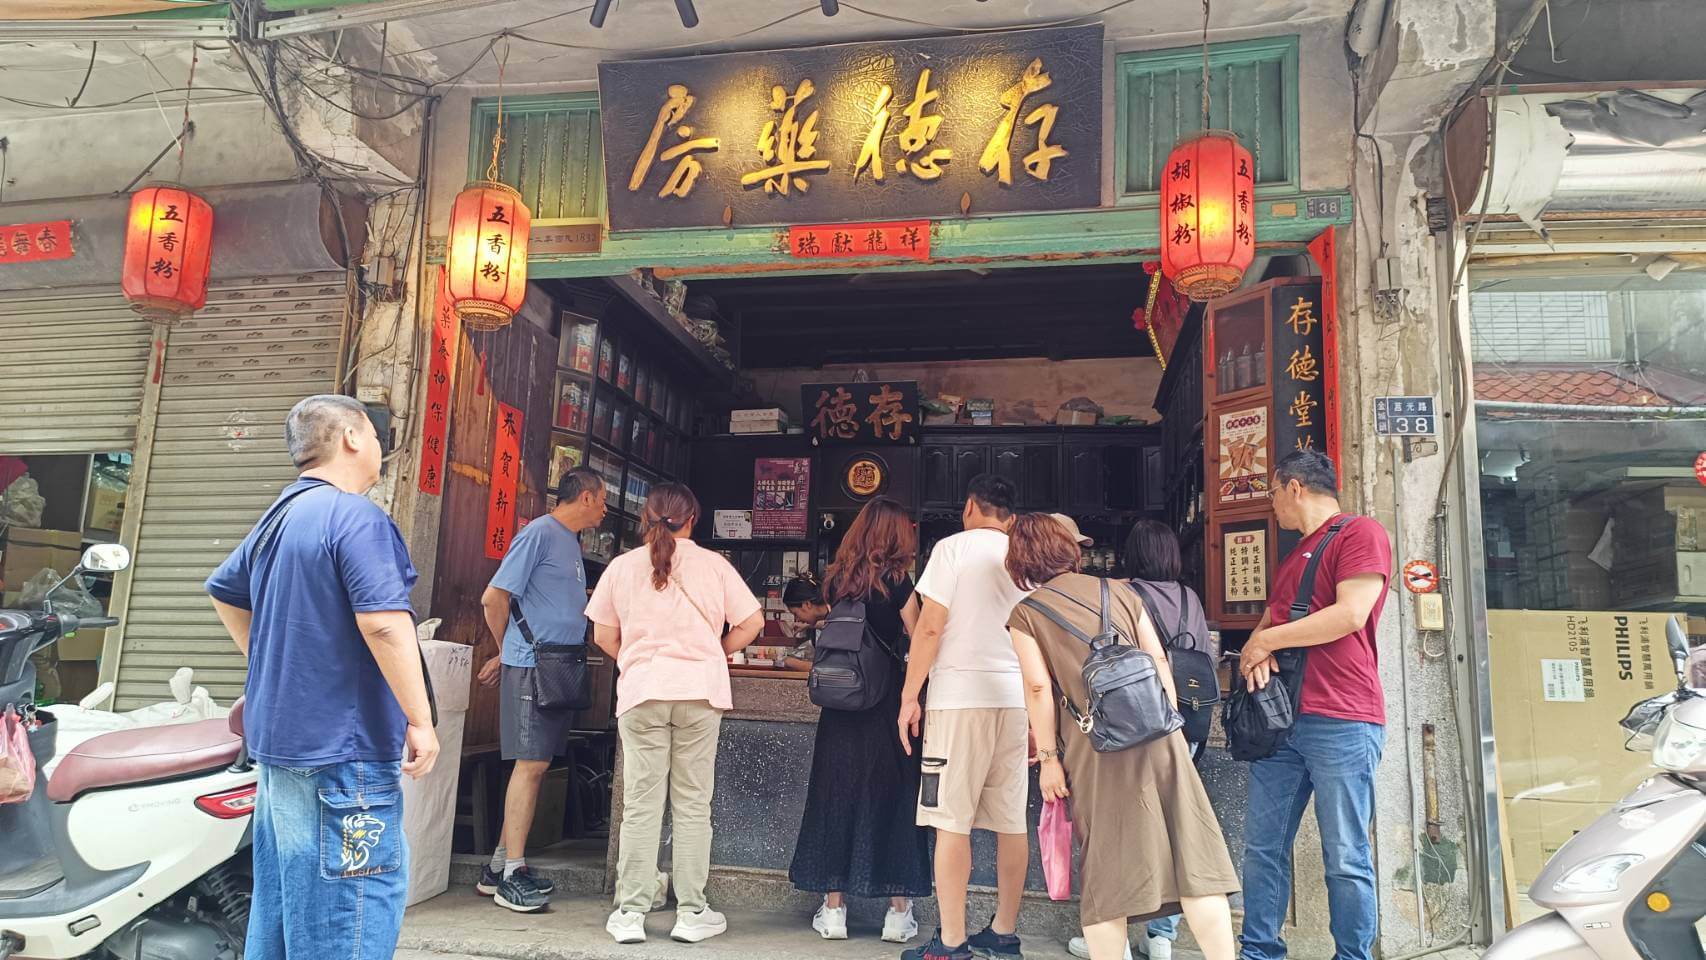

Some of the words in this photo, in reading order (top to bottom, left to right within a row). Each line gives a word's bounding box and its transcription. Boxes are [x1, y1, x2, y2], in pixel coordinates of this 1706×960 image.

[1170, 159, 1195, 246] 胡椒粉
[1236, 159, 1252, 246] 五香粉
[1319, 202, 1337, 214] 38
[150, 205, 184, 279] 五香粉
[480, 206, 510, 282] 五香粉
[1396, 417, 1428, 433] 38
[492, 411, 517, 551] 恭賀新禧
[1566, 615, 1578, 652] HD2105
[1614, 616, 1633, 681] PHILIPS
